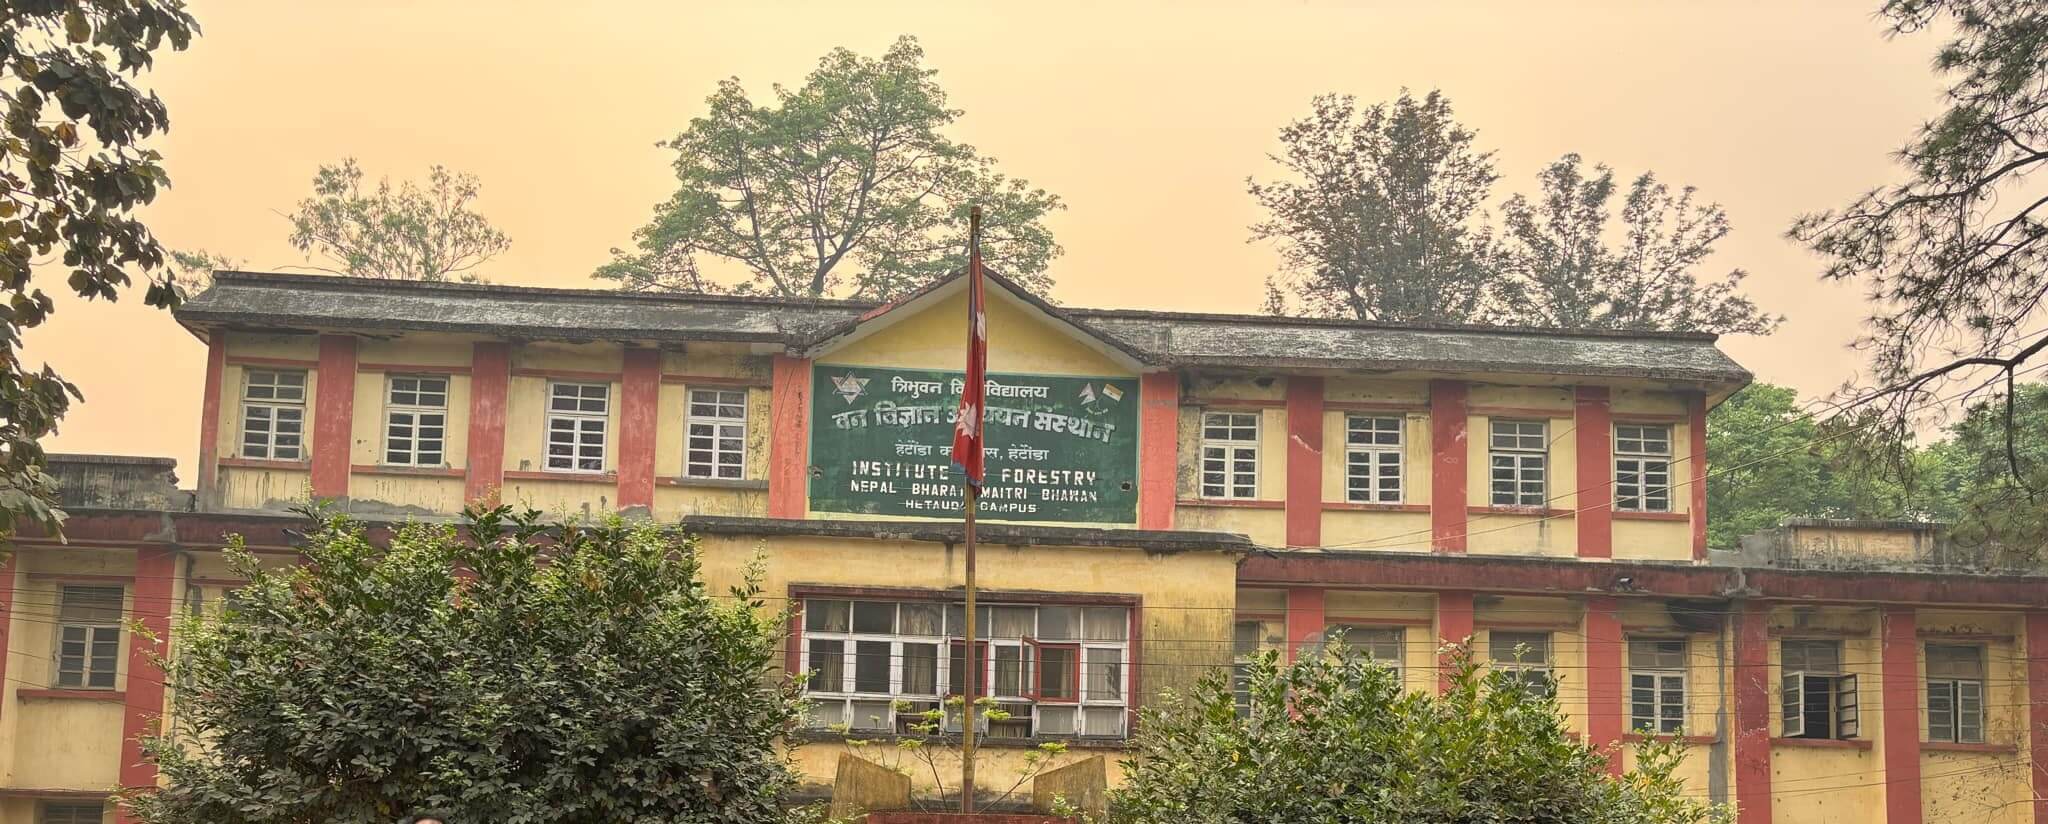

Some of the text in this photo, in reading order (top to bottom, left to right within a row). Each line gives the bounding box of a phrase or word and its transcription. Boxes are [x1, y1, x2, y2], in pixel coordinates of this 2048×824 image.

[891, 376, 1050, 398] त्रिभुवन विविद्यालय
[832, 409, 867, 429] वन
[873, 400, 941, 428] विज्ञान
[1033, 407, 1115, 443] संस्थान
[852, 460, 949, 480] INSTITUTE
[1001, 468, 1096, 486] FORESTRY
[850, 480, 897, 494] NEPAL
[980, 487, 1027, 500] MAITRI
[1041, 488, 1098, 503] BHAWAN
[980, 501, 1037, 513] CAMPUS
